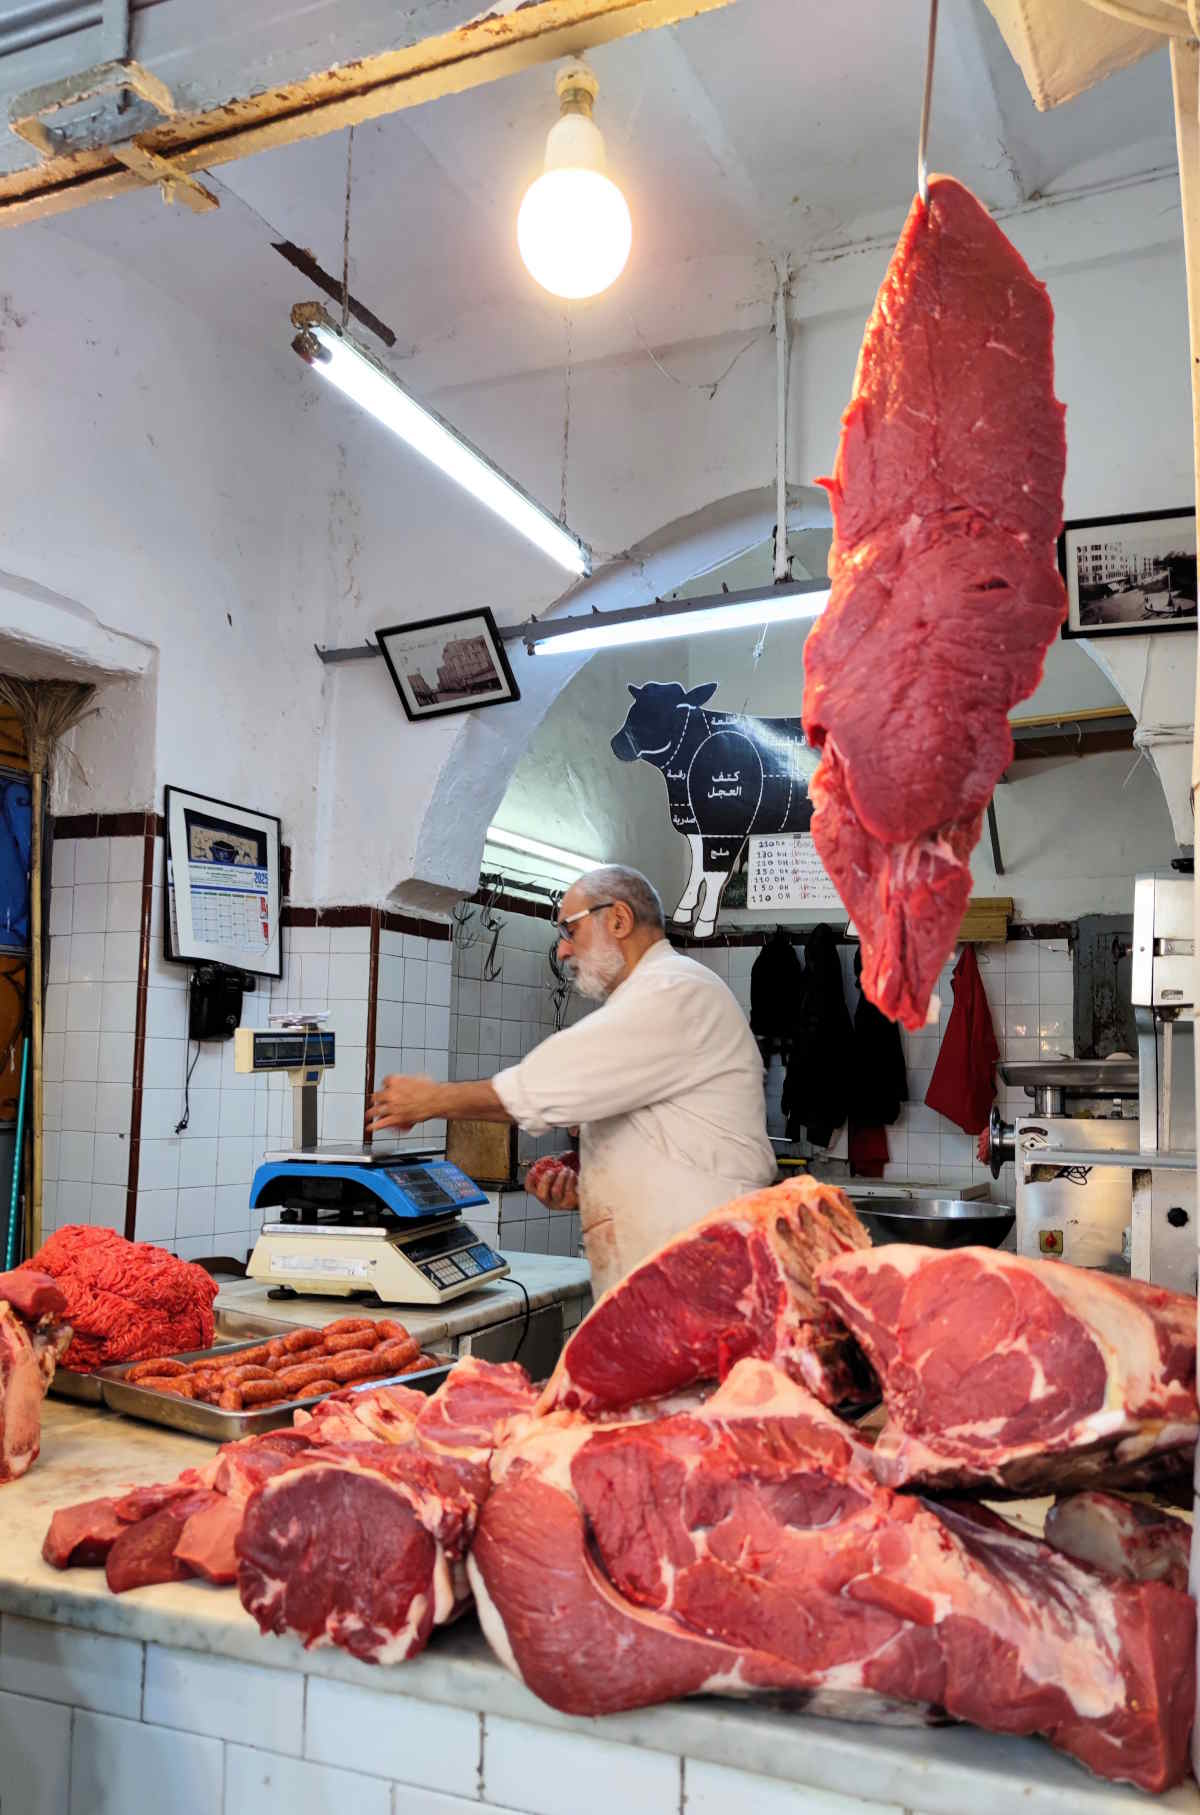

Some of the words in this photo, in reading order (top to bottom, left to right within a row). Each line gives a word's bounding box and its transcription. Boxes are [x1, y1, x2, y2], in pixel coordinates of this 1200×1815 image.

[712, 771, 740, 782] كتف
[707, 785, 742, 799] العجل
[673, 814, 697, 825] صدرية
